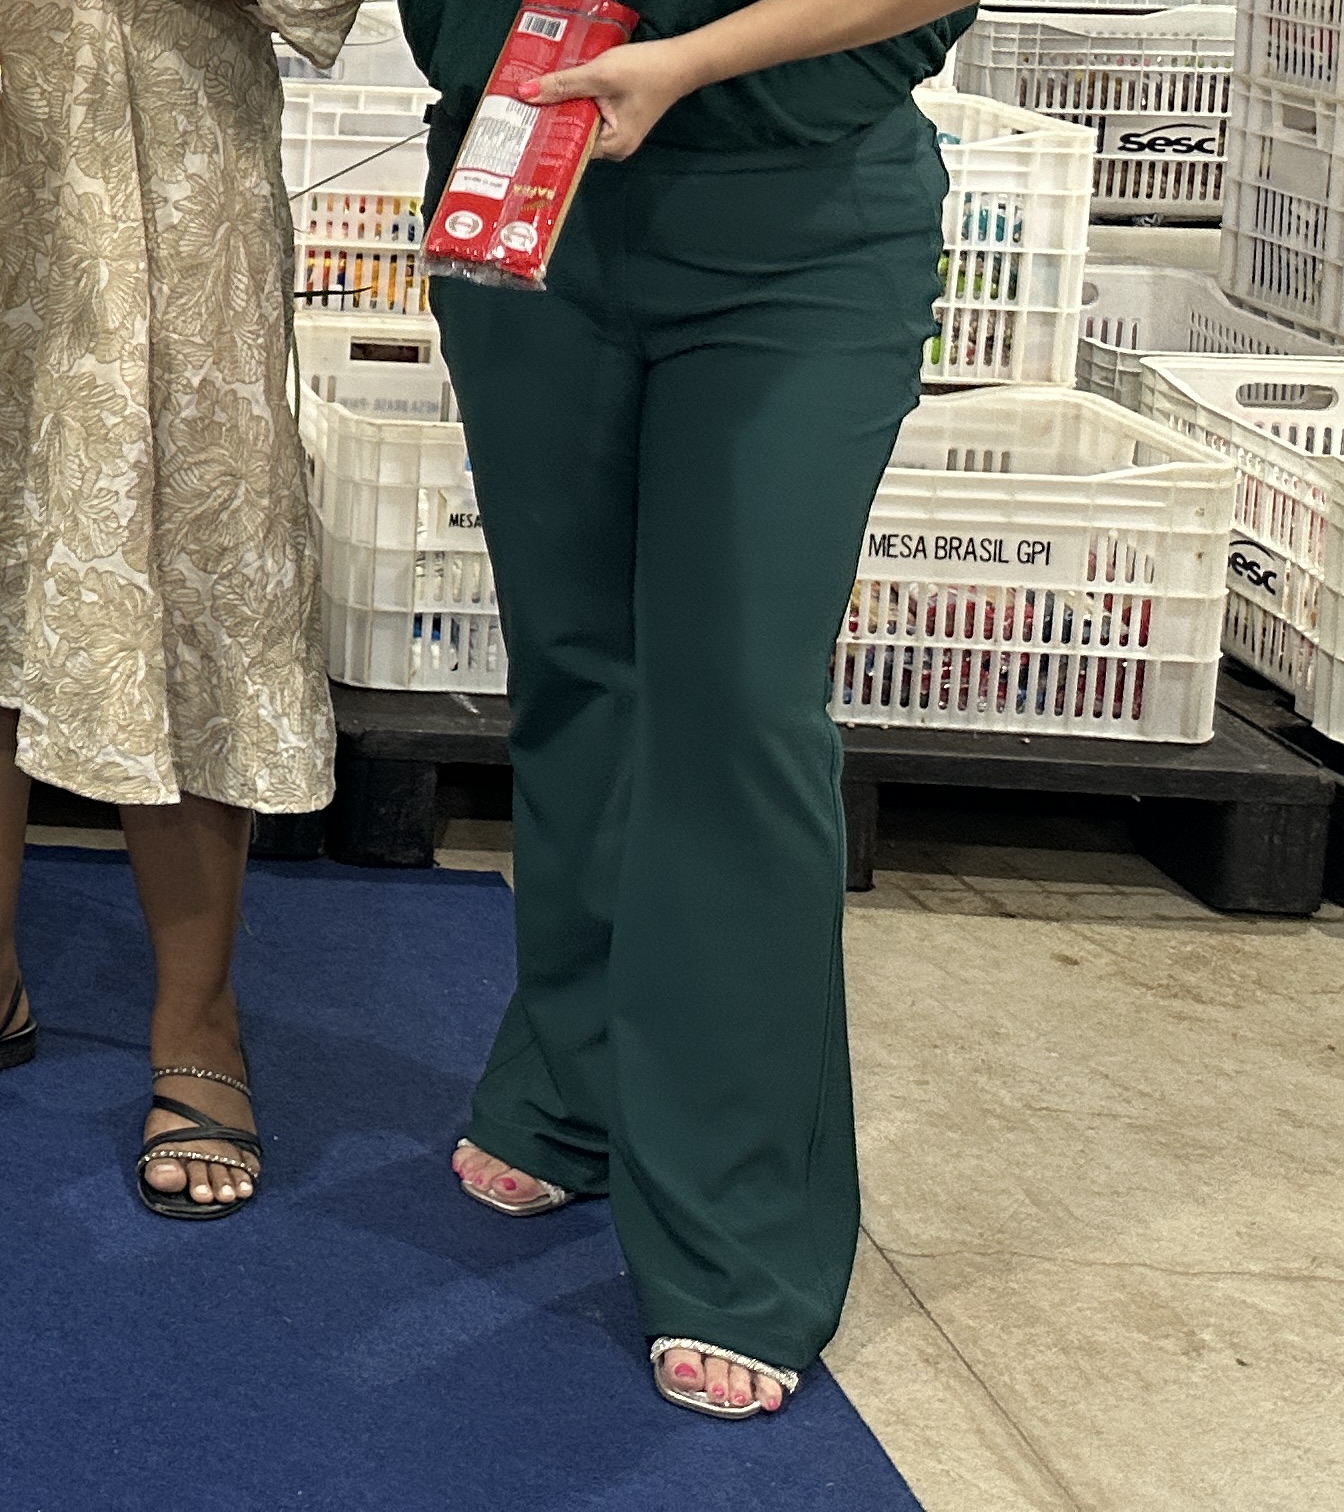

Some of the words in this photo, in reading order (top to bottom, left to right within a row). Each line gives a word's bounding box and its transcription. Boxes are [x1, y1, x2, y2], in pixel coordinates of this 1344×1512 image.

[867, 533, 928, 561] MESA
[934, 536, 1010, 564] BRASIL
[1017, 540, 1051, 566] GPI
